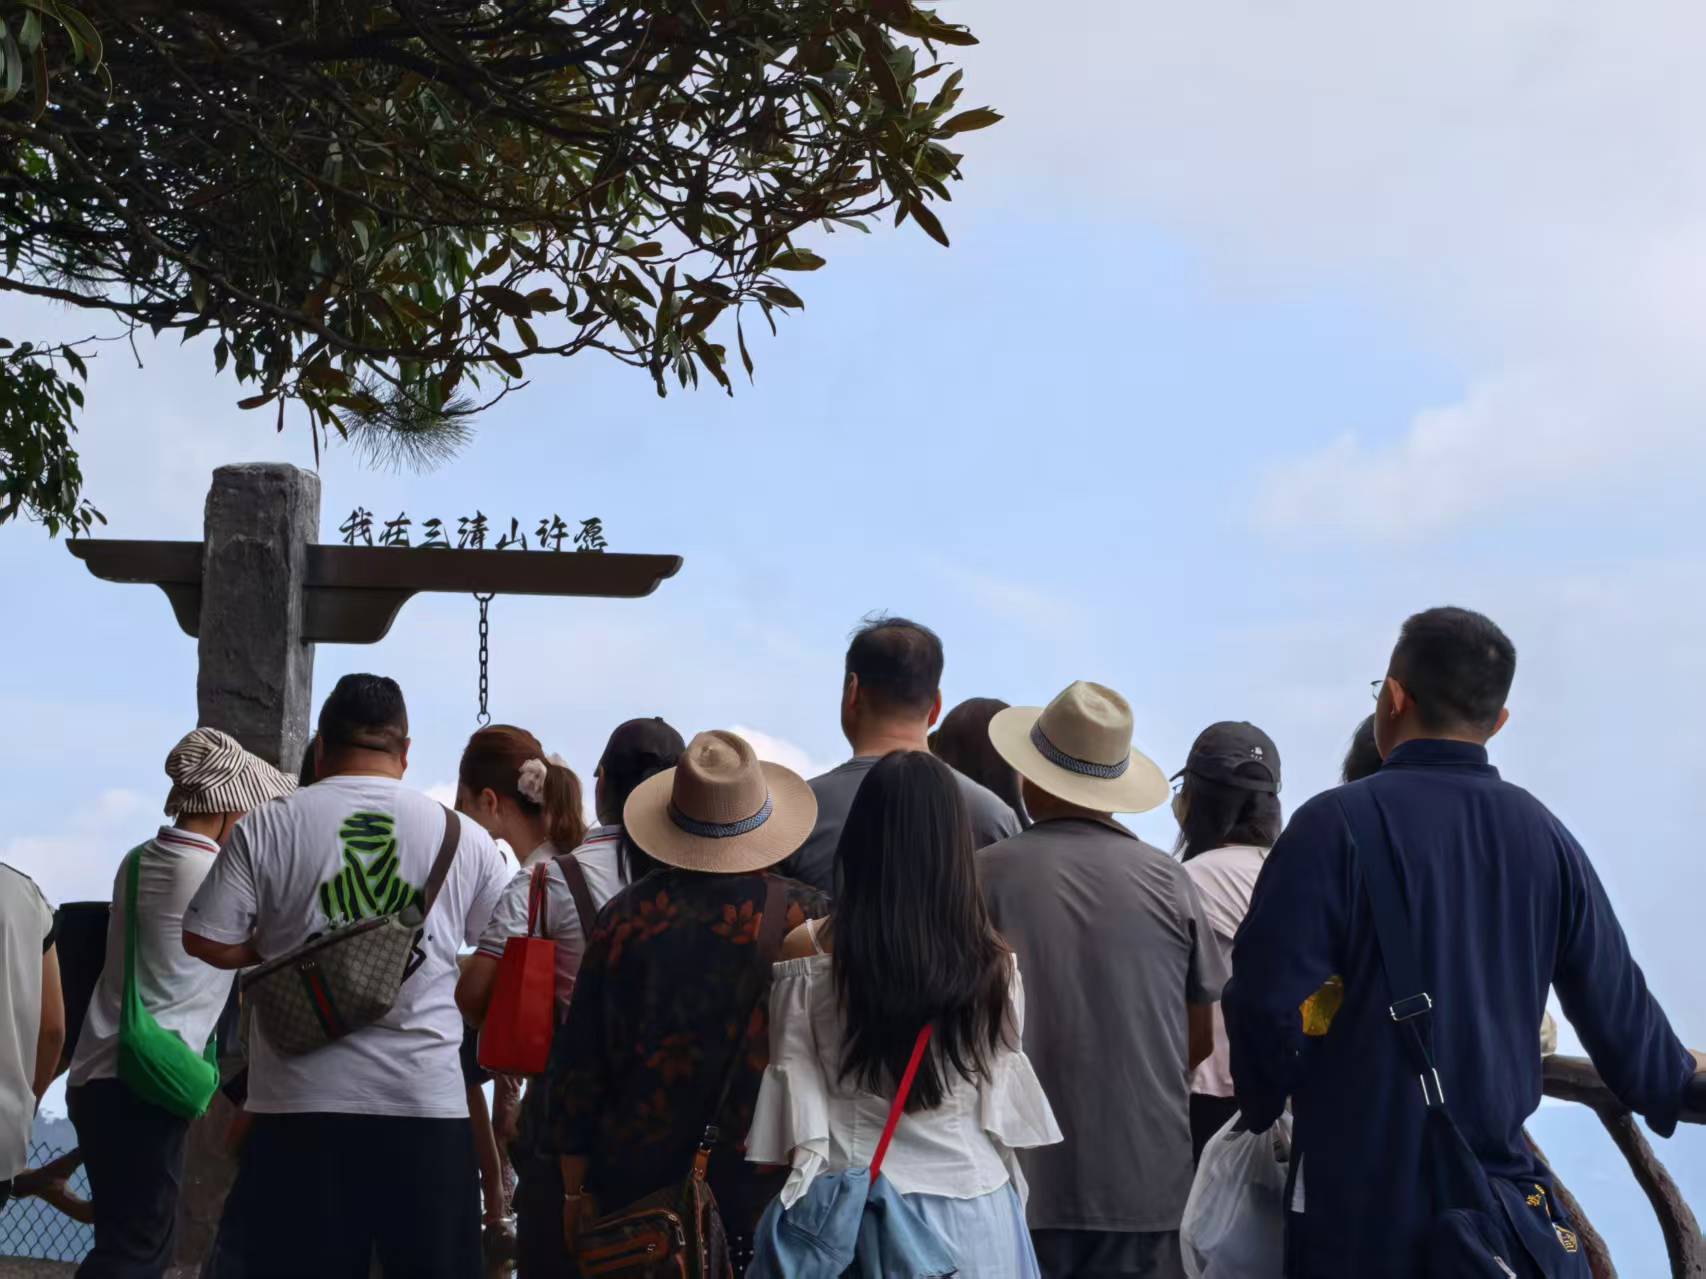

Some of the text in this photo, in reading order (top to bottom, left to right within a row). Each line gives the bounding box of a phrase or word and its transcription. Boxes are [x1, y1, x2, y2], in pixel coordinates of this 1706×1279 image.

[339, 506, 608, 552] 我在三清山许愿
